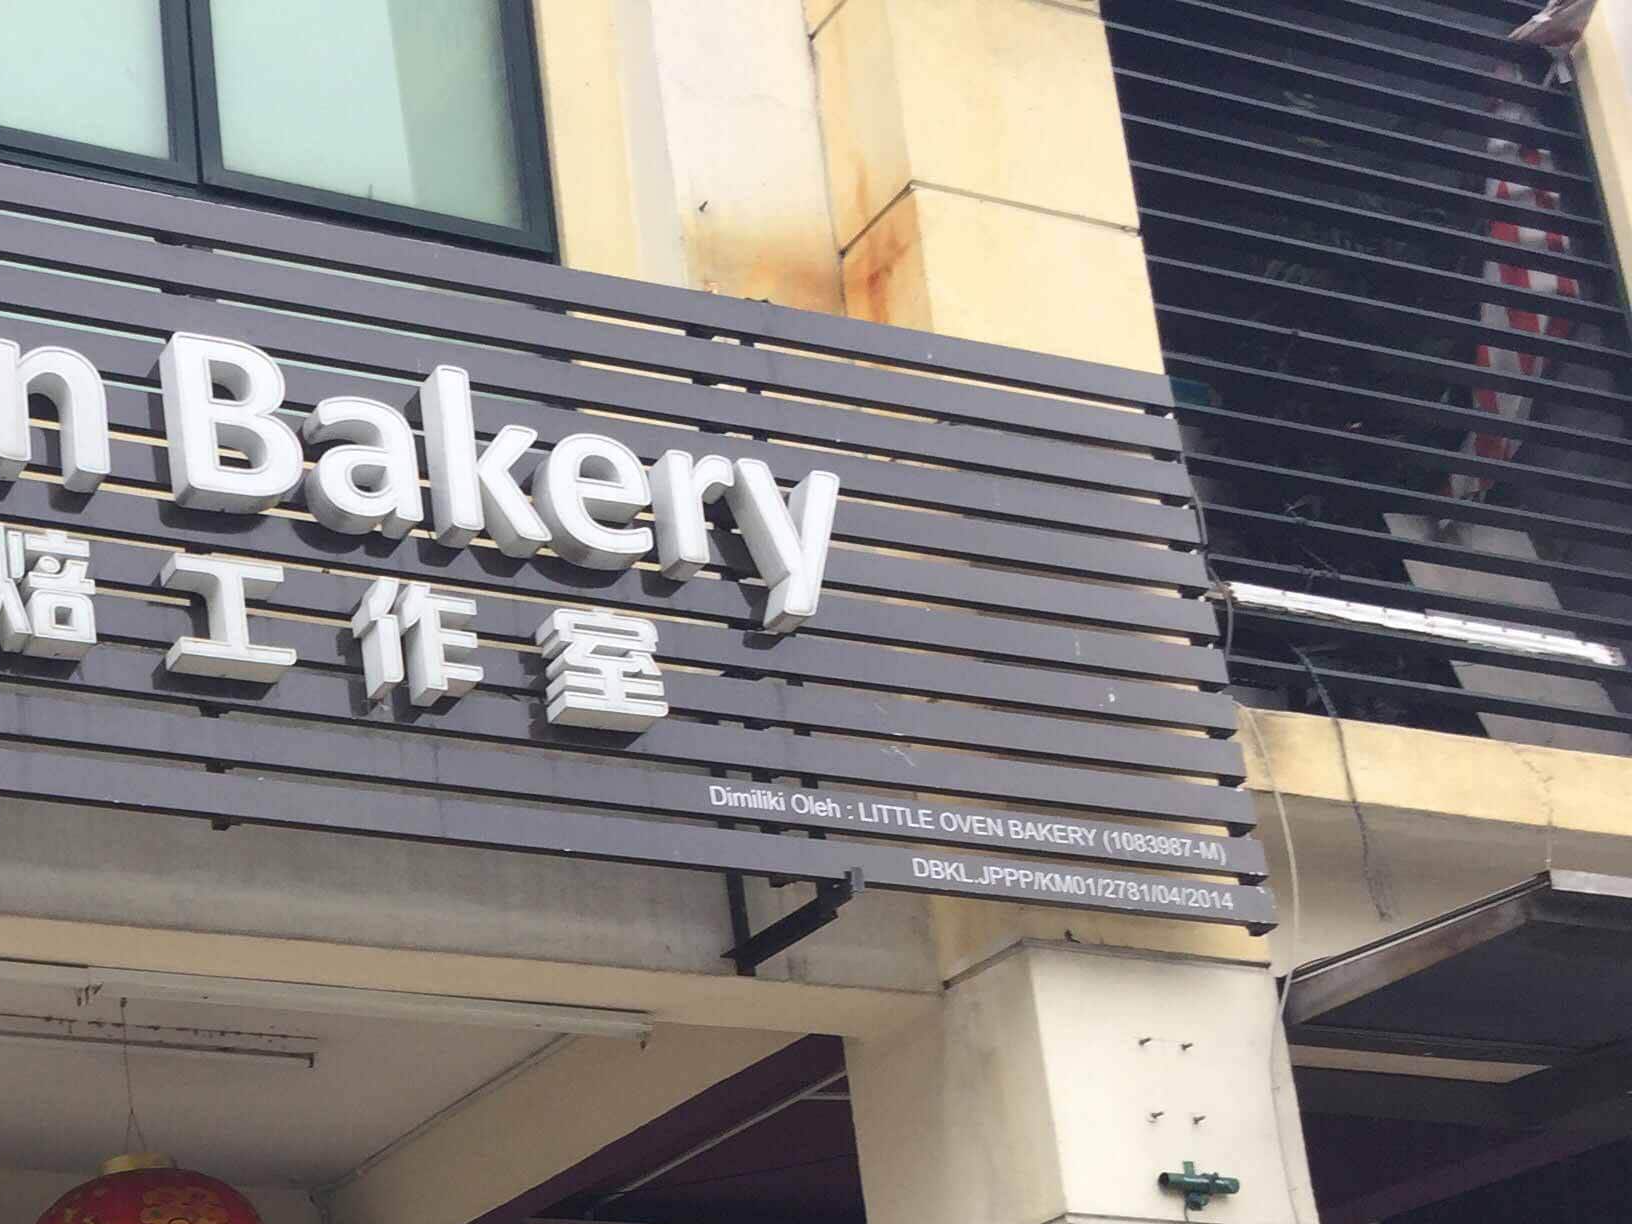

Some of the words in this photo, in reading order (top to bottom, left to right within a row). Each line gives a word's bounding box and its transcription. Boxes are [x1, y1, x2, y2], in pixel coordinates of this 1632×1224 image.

[158, 329, 840, 636] Bakery
[708, 784, 786, 812] Dimiliki
[789, 793, 842, 819] Oleh
[858, 802, 935, 829] LITTLE
[939, 812, 1005, 838] OVEN
[1007, 819, 1097, 847] BAKERY
